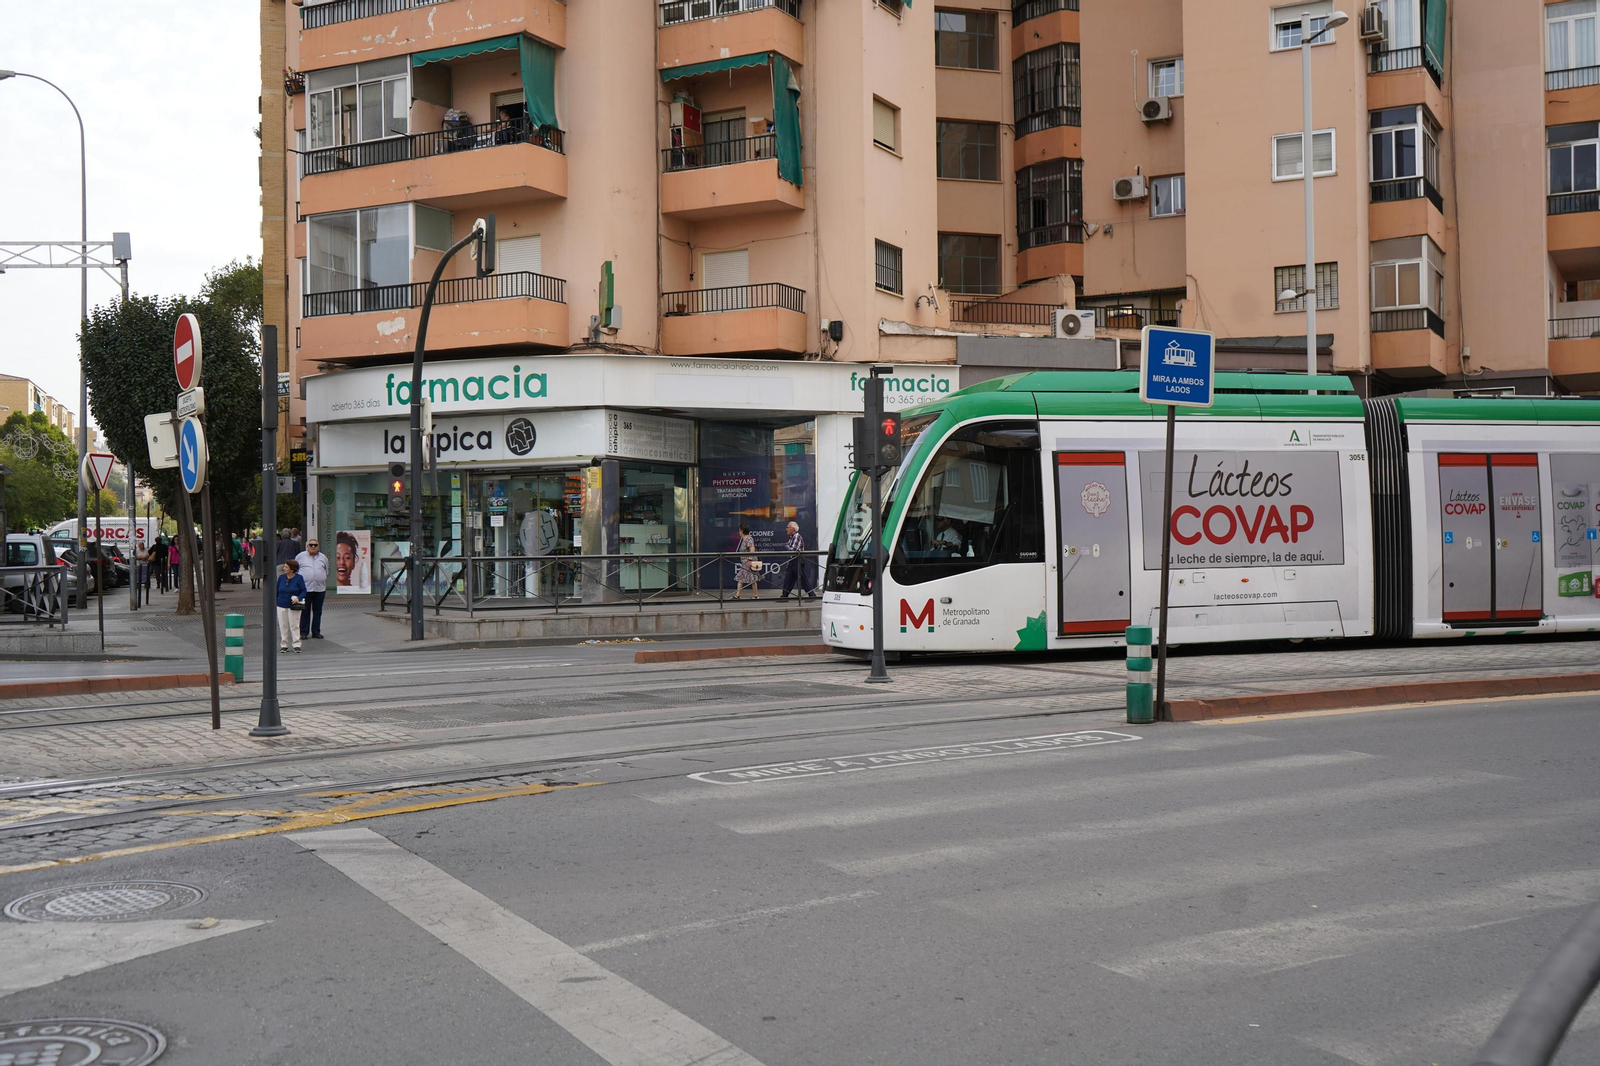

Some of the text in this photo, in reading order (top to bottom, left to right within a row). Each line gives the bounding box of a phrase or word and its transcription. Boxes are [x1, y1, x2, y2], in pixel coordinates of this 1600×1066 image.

[850, 372, 949, 392] famacia
[1152, 375, 1171, 384] MIRA
[1178, 378, 1204, 387] AMBOS
[1166, 385, 1191, 395] LADOS
[331, 398, 381, 411] abierto 365 días
[898, 395, 914, 404] 365
[623, 422, 633, 430] 365
[384, 424, 492, 458] la ípica
[1188, 454, 1293, 498] Lácteos
[1449, 489, 1480, 502] Lácteos
[1500, 496, 1536, 506] ENVASE
[1444, 503, 1486, 515] COVAP
[1557, 502, 1586, 510] COVAP
[1170, 504, 1314, 546] COVAP
[1177, 553, 1206, 564] leche
[1208, 553, 1222, 564] de
[1225, 552, 1270, 565] siempre,
[1272, 552, 1281, 562] la
[1284, 552, 1297, 562] de
[1300, 550, 1325, 563] aquí.
[1213, 592, 1278, 601] lacteoscovap.com
[942, 608, 990, 617] Metropolitano
[942, 617, 980, 626] de Granada
[730, 762, 824, 779] MIRE
[867, 747, 994, 765] AMBOS
[1000, 734, 1105, 750] LADOS
[0, 1024, 132, 1047] fónica
